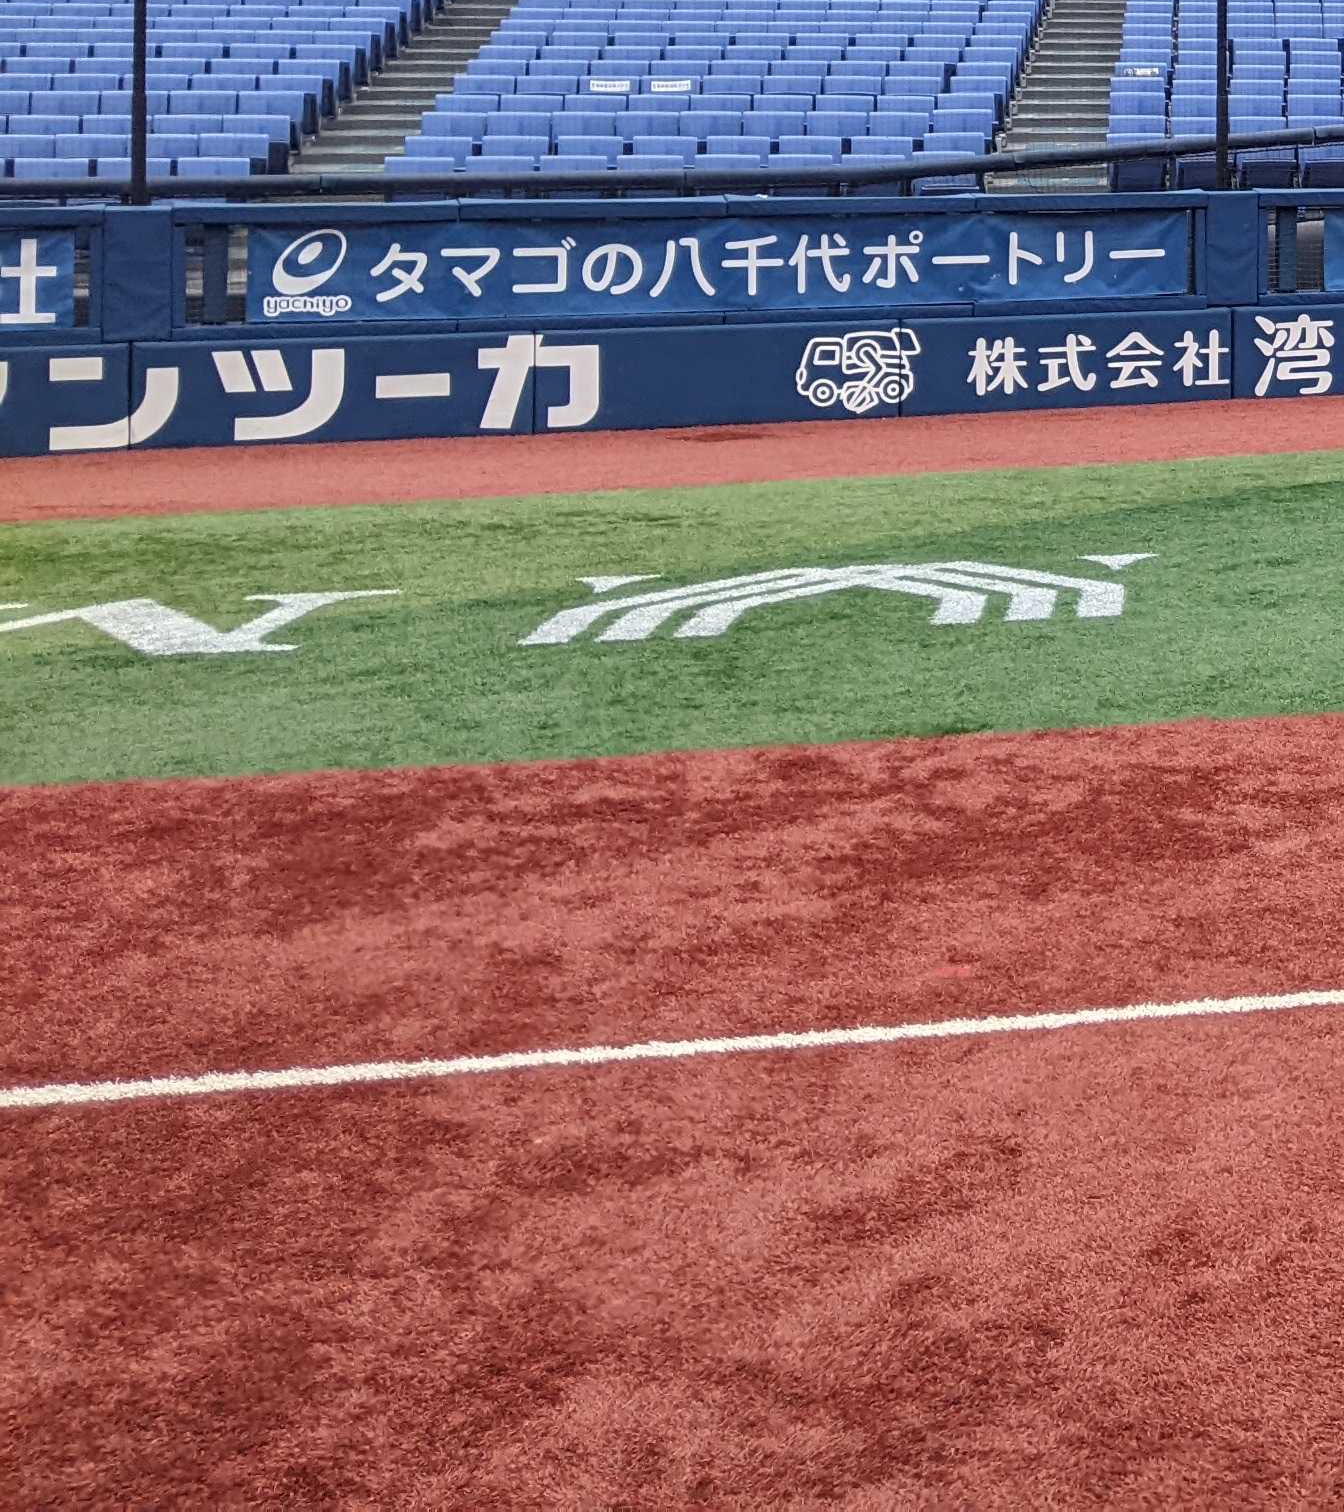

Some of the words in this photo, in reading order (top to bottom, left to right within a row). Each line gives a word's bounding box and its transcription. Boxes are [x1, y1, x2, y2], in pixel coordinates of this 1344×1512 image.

[369, 230, 1166, 303] タマゴの八千代ポートリー
[263, 294, 353, 317] yachiyo
[0, 334, 600, 451] ンツーカ
[966, 327, 1233, 397] 株式会社
